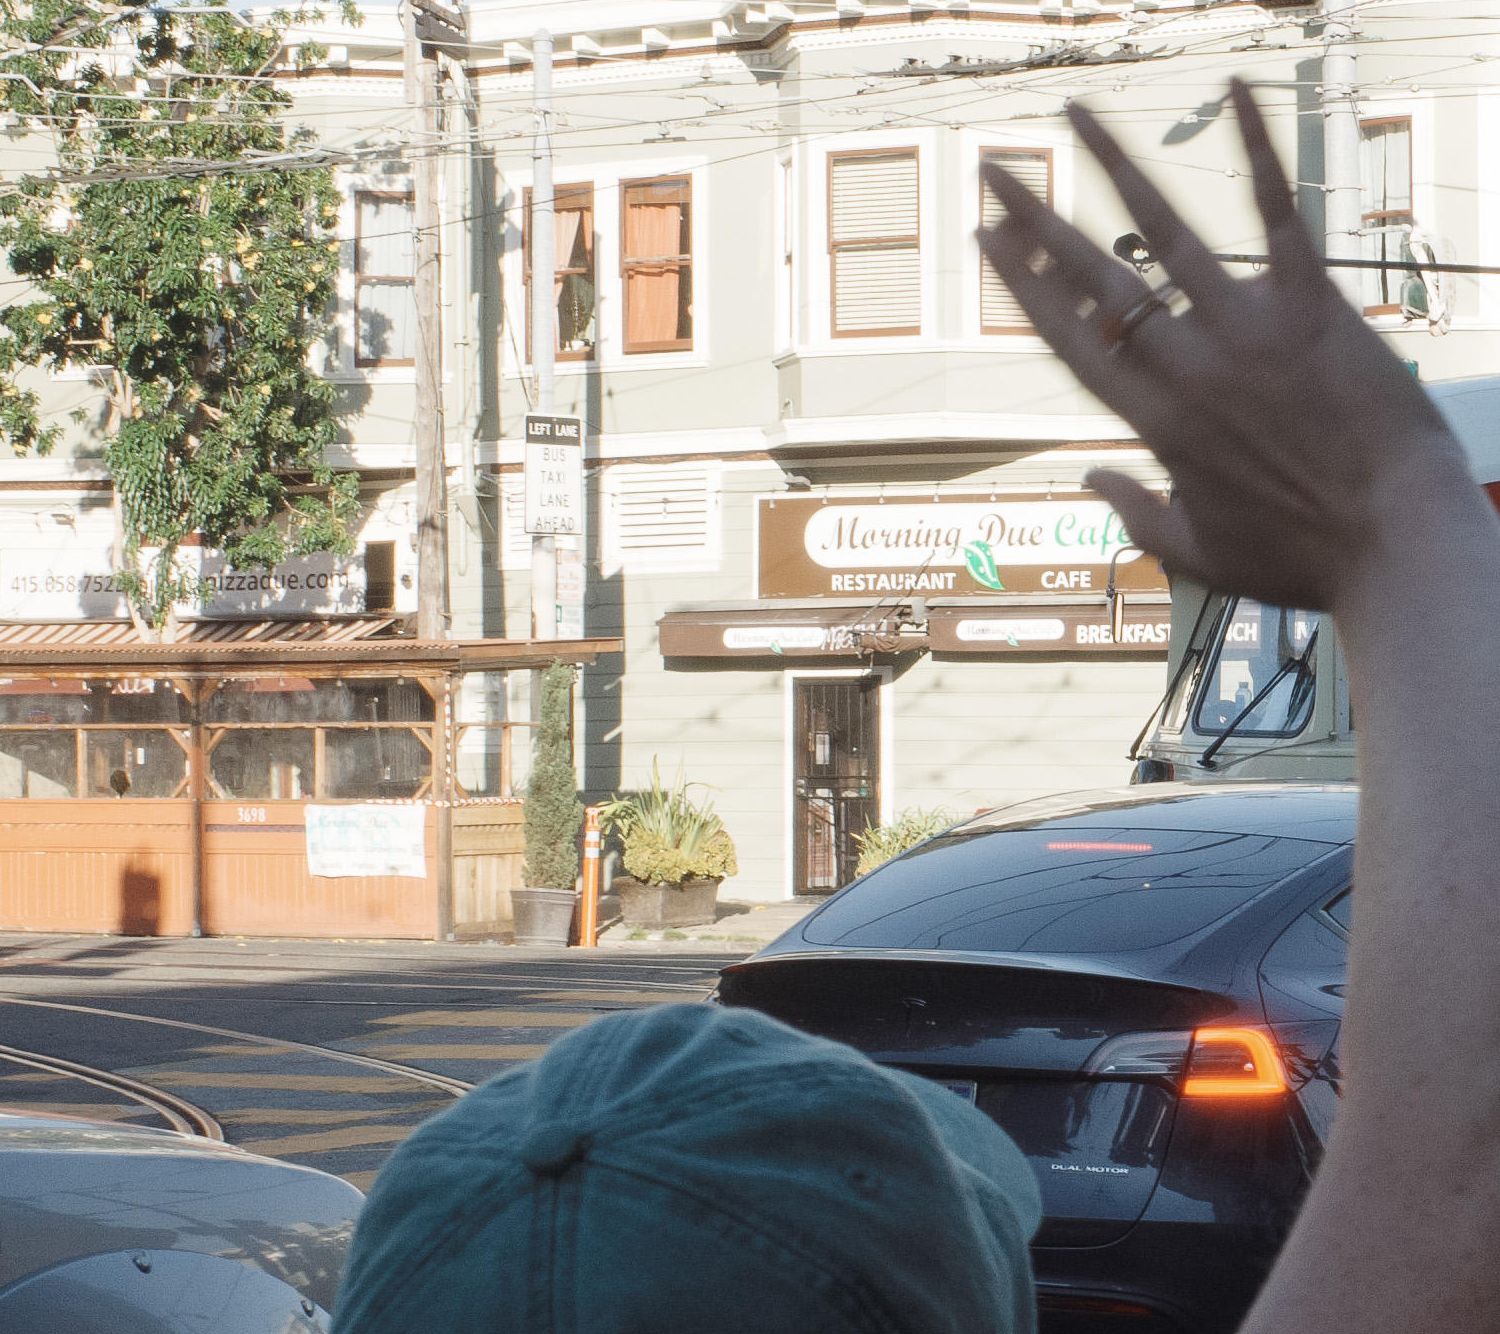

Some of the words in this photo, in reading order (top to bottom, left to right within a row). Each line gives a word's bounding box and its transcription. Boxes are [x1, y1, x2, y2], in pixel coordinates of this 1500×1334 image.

[529, 422, 551, 436] LEFT
[555, 423, 579, 438] LANE
[543, 448, 566, 462] BUS
[540, 470, 566, 485] TAXI
[540, 494, 570, 508] LANE
[535, 516, 575, 531] AHEAD
[821, 515, 962, 559] Morning
[978, 514, 1044, 548] Due
[831, 572, 956, 591] RESTAURANT
[1041, 571, 1091, 588] CAFE
[237, 807, 266, 823] 3698
[1051, 1163, 1082, 1172] DUAL
[1085, 1165, 1129, 1174] MOTOR
